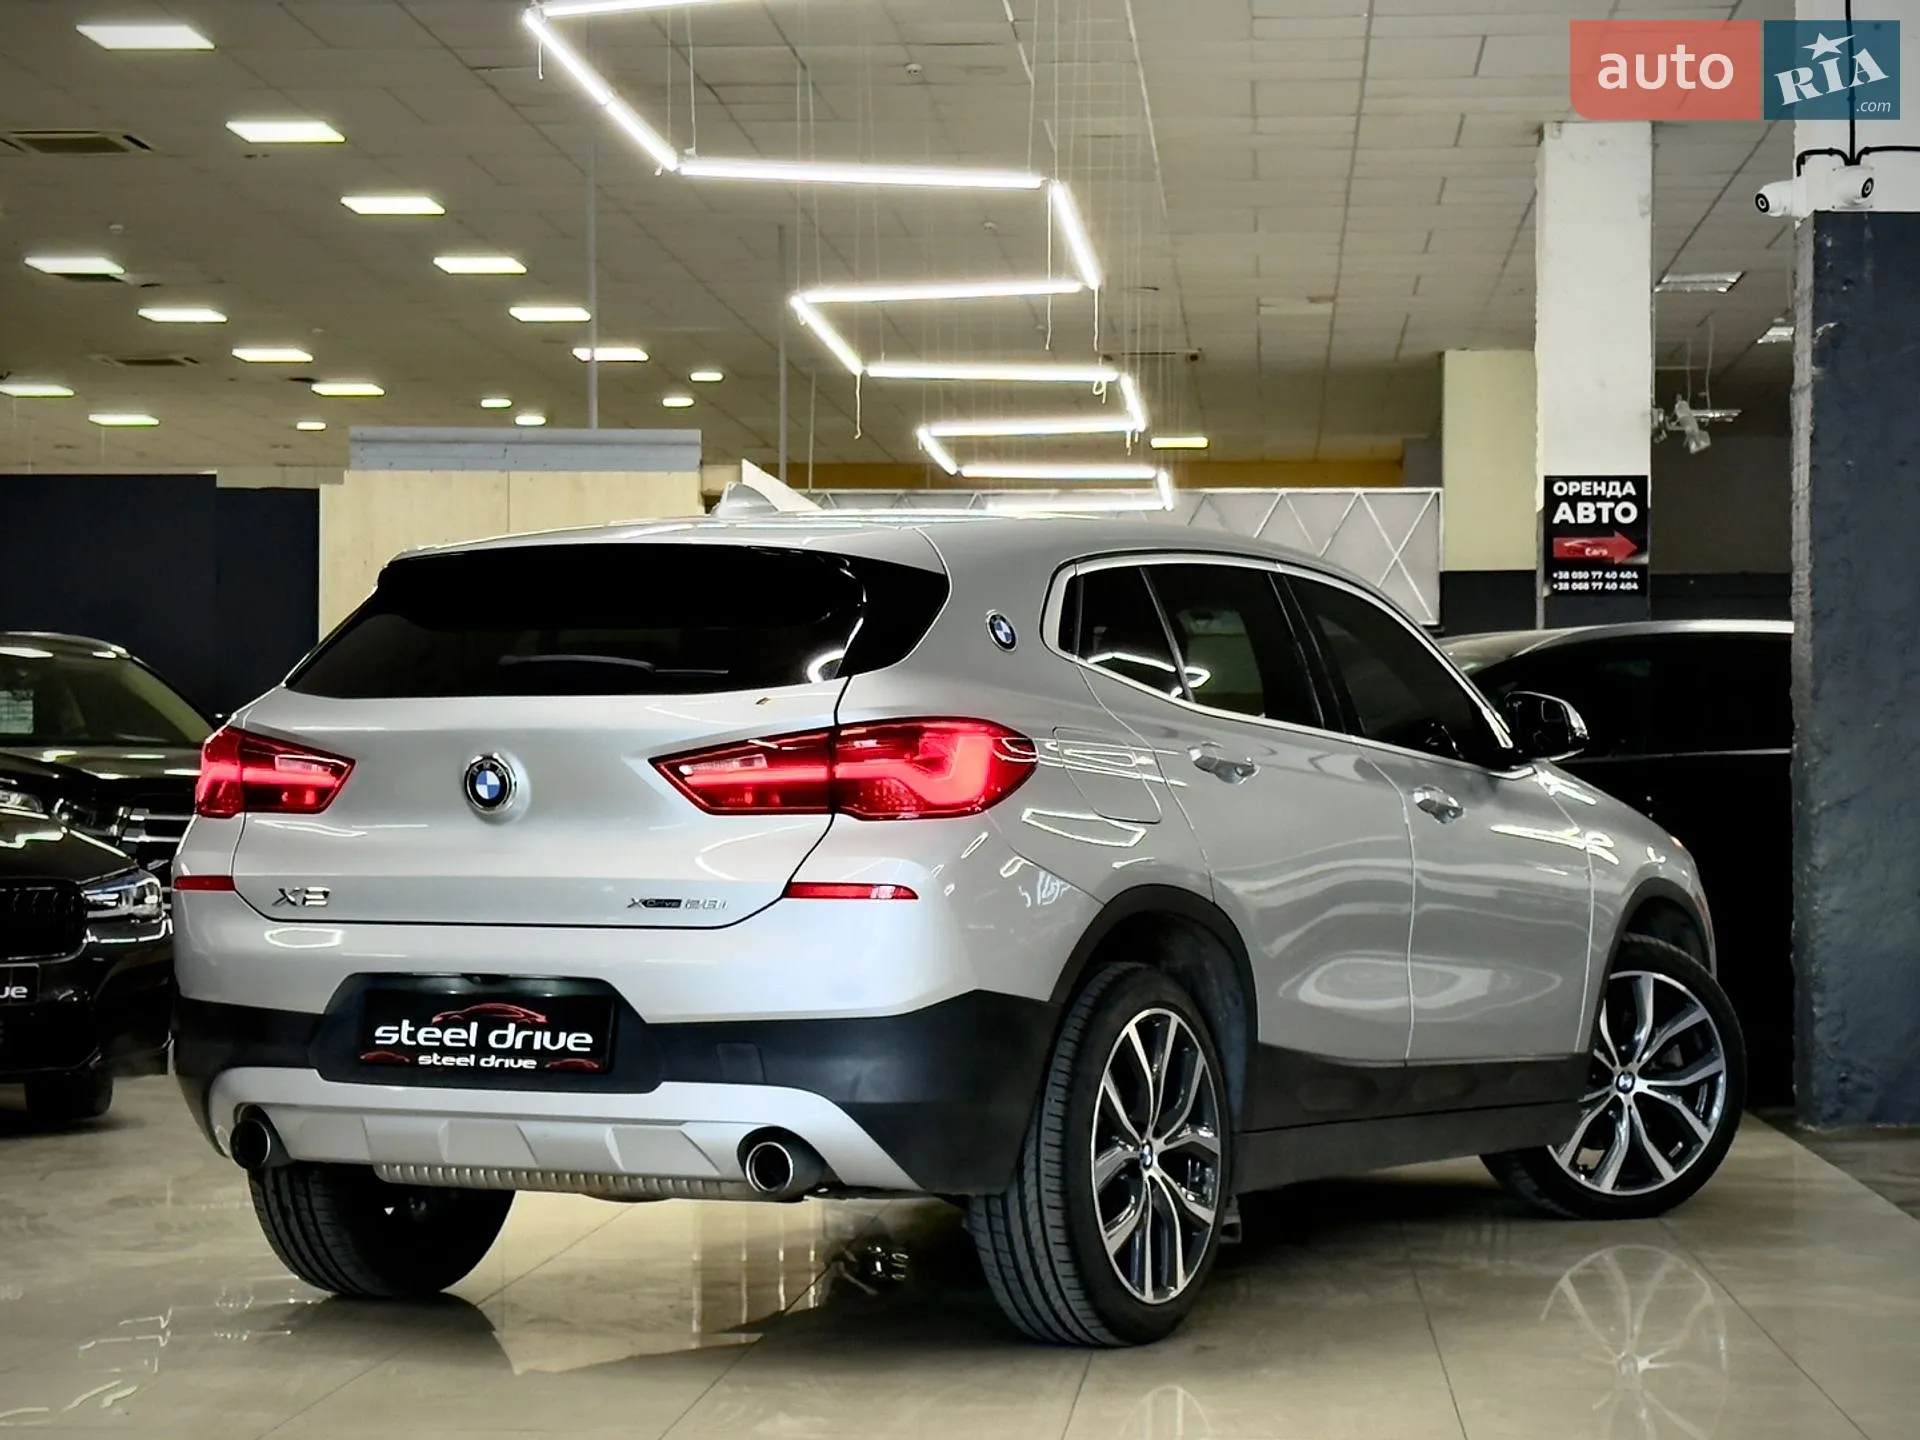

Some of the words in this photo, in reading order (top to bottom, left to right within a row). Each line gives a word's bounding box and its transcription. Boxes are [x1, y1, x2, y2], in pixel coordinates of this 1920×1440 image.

[1553, 481, 1637, 498] ОРЕНДА
[1552, 501, 1638, 524] АВТО
[1591, 571, 1604, 579] 77
[1604, 571, 1618, 579] 40
[1619, 571, 1639, 579] 404
[1591, 582, 1604, 590] 77
[1604, 582, 1618, 590] 40
[1619, 582, 1639, 590] 404
[374, 1018, 478, 1048] steel
[487, 1021, 594, 1052] drive
[418, 1053, 476, 1067] steel
[480, 1054, 538, 1069] drive
